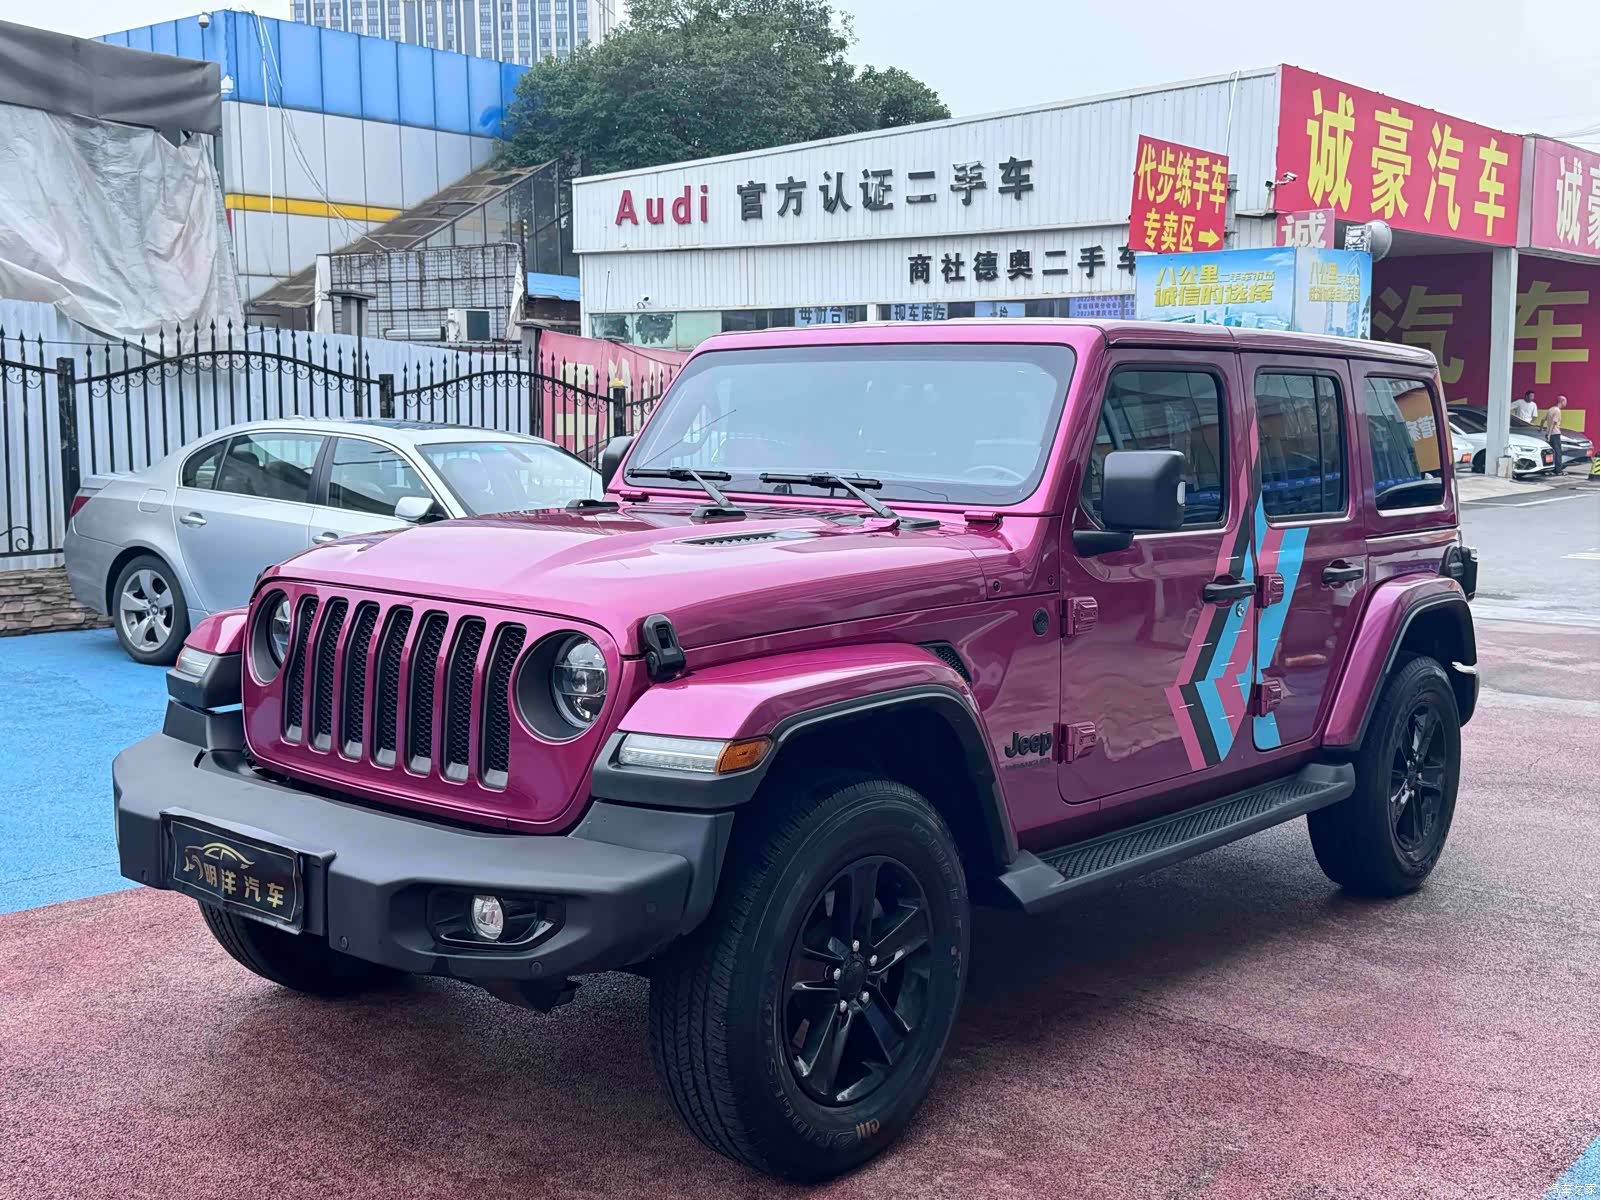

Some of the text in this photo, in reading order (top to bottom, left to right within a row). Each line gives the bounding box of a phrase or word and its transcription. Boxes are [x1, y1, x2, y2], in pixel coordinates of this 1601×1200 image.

[1137, 142, 1227, 215] 代步练手车
[1305, 87, 1509, 237] 诚豪汽车
[615, 184, 709, 226] Audi
[736, 156, 1034, 222] 官方认证二手车
[1143, 207, 1196, 252] 专卖区
[1154, 282, 1273, 308] 诚信的选择
[1004, 731, 1053, 758] Jeep
[204, 862, 285, 909] 明洋汽车
